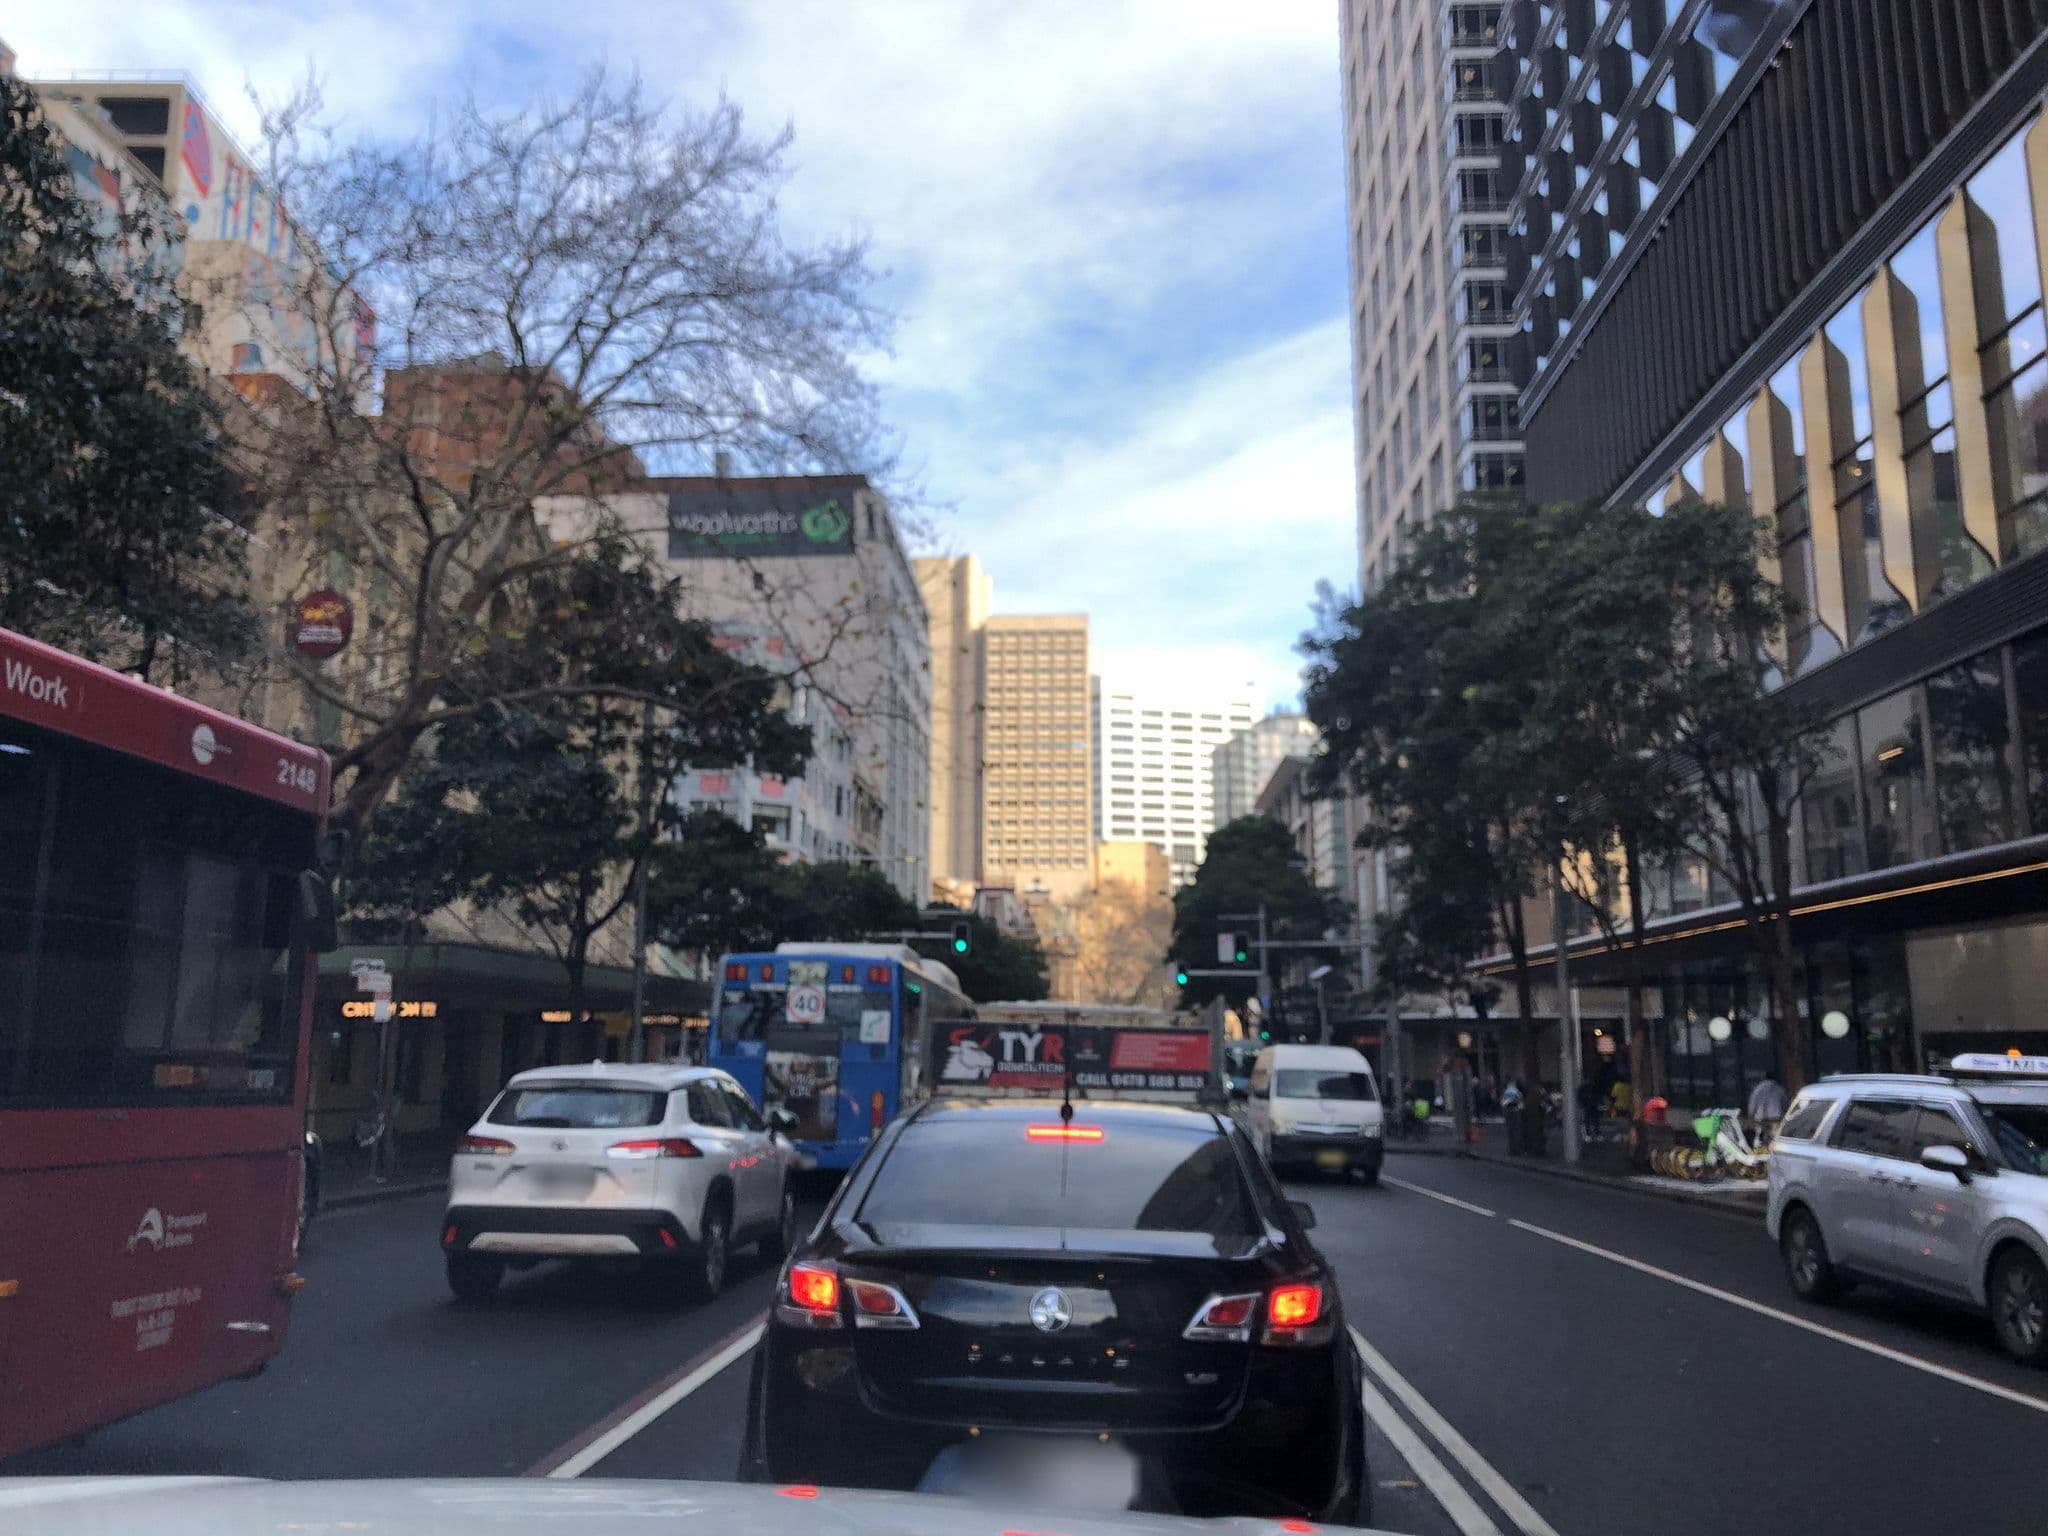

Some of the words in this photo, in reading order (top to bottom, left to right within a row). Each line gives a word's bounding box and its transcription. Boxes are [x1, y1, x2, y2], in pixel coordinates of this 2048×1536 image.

[4, 657, 69, 708] Work
[794, 994, 820, 1013] 40
[998, 1031, 1066, 1063] TYR
